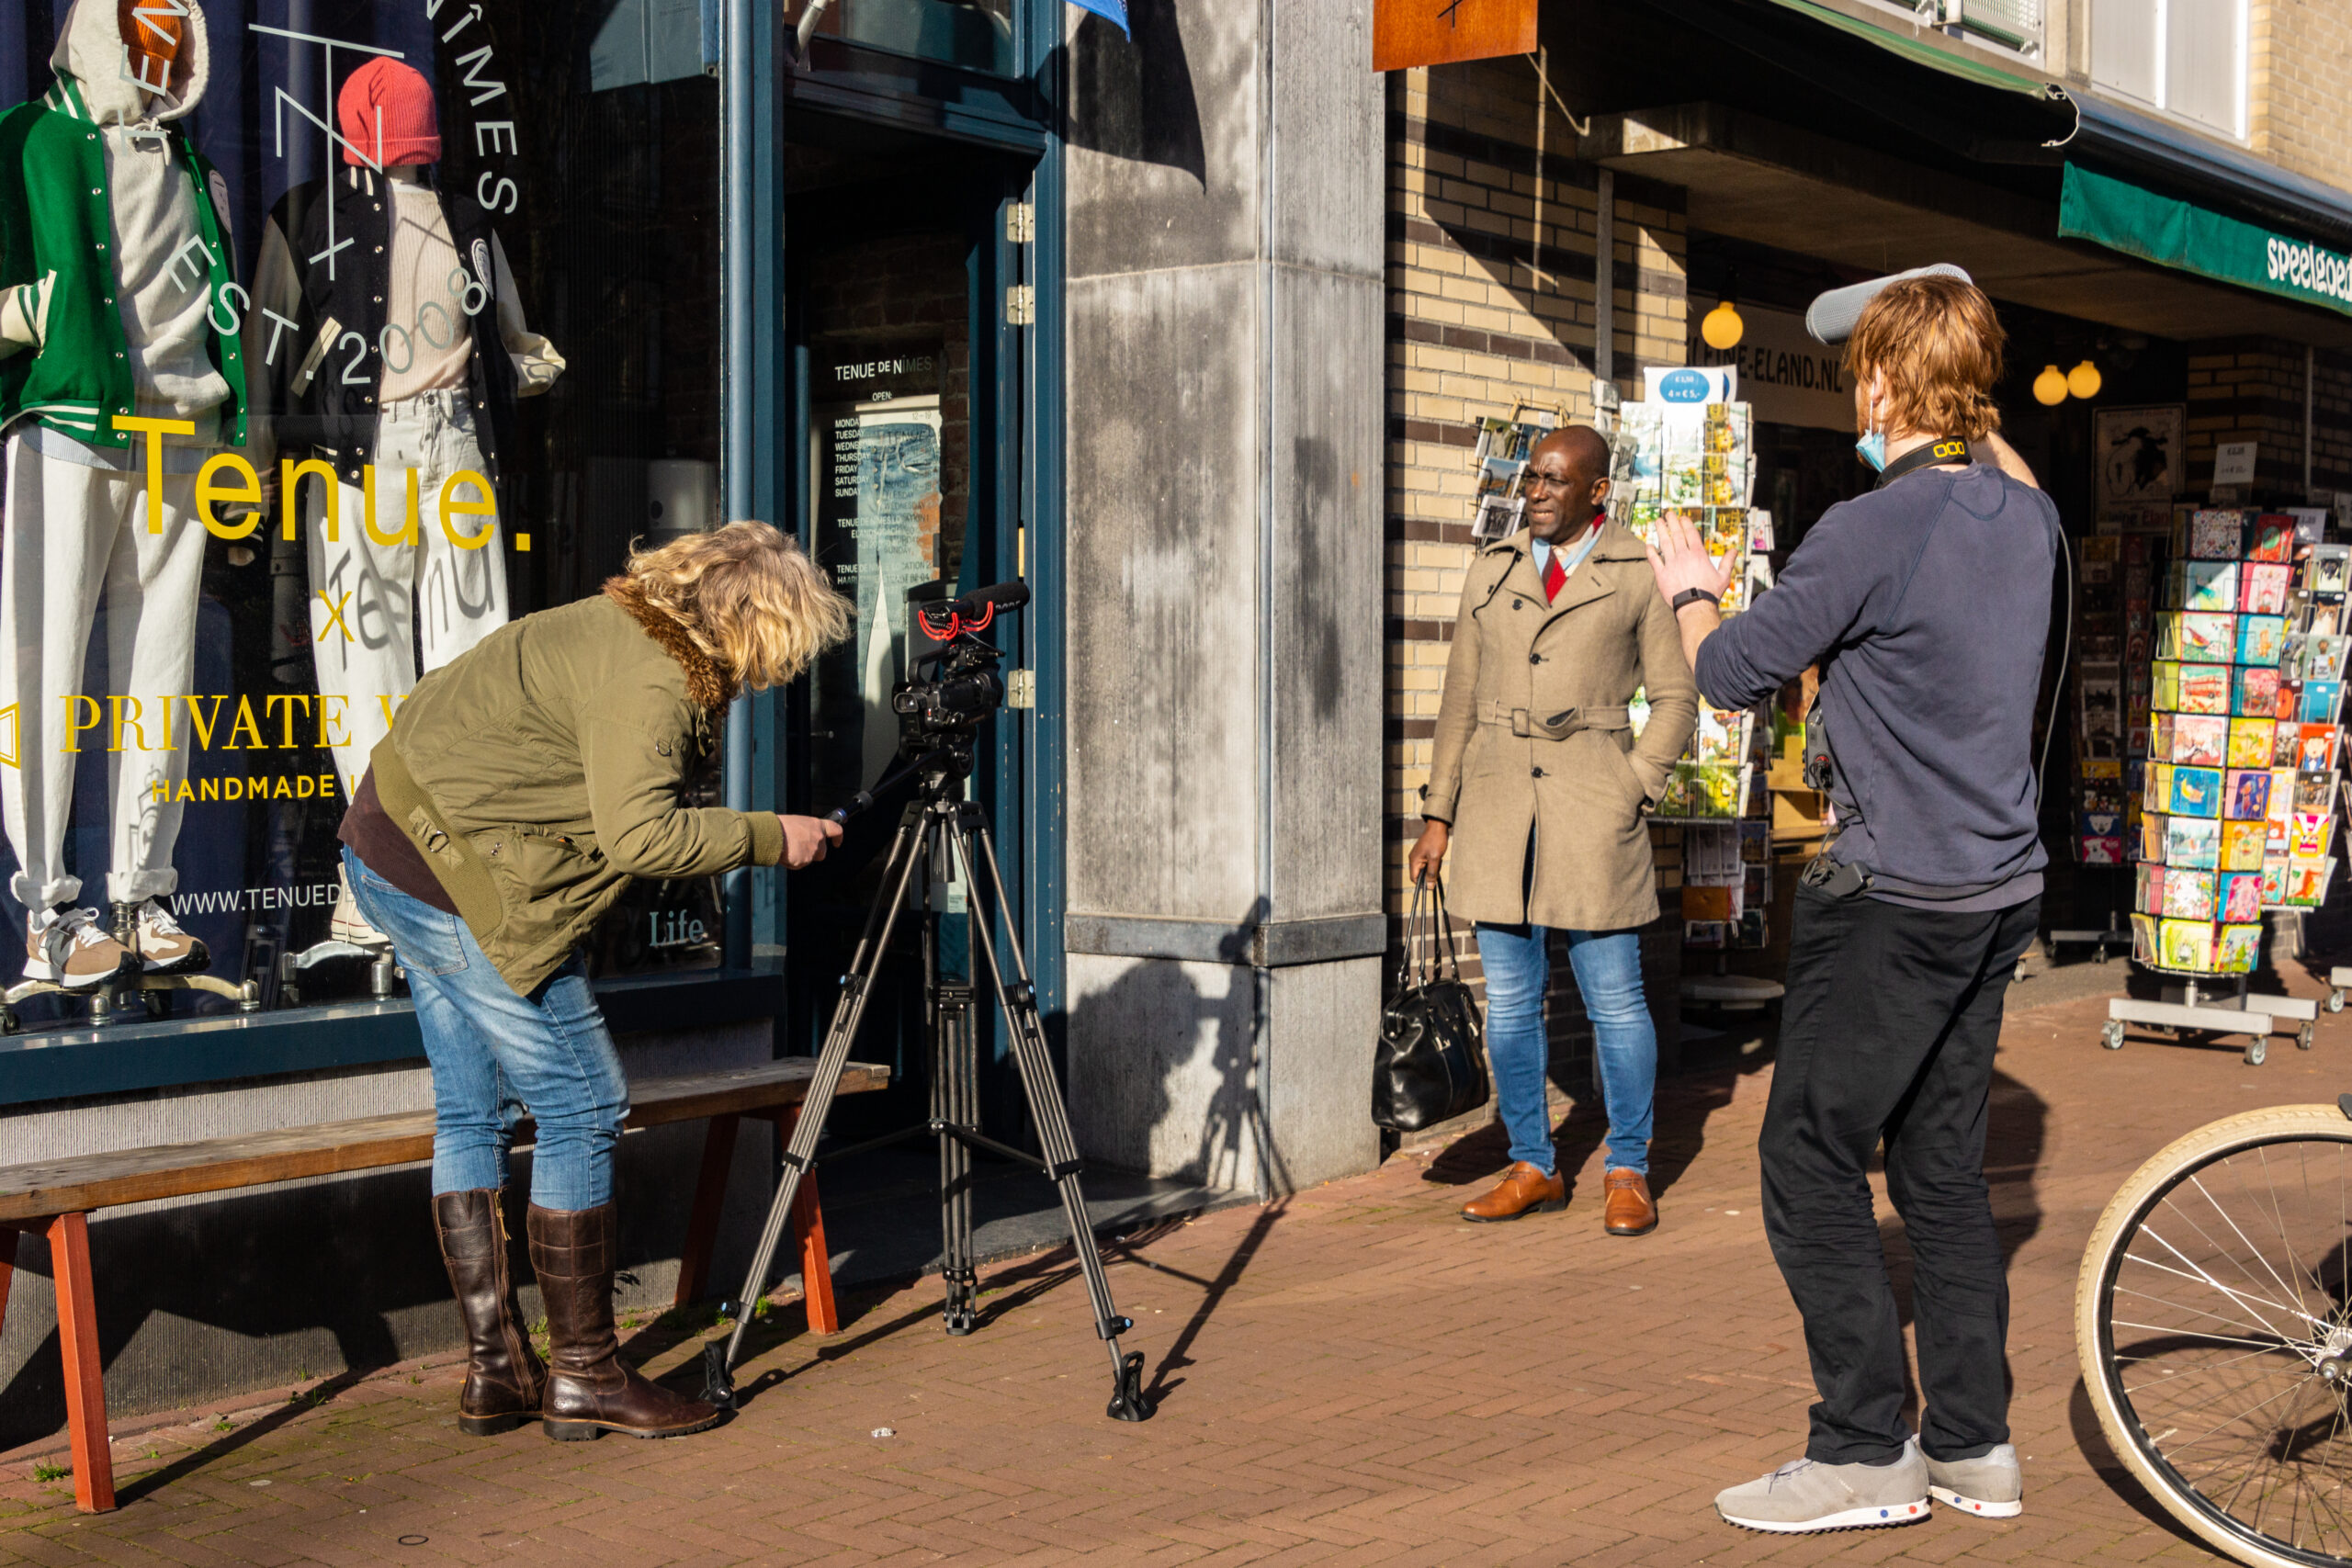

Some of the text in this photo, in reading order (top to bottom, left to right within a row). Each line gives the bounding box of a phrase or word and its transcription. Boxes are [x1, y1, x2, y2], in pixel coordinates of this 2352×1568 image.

[338, 266, 487, 385] 2008
[835, 363, 875, 380] TENUE
[878, 361, 891, 372] DE
[835, 418, 861, 428] MONDA
[835, 429, 865, 440] TUESDAY
[835, 453, 870, 463] THURSDAY
[835, 465, 858, 475] FRIDAY
[112, 415, 531, 551] Tenue.
[835, 476, 870, 486] SATURDAY
[59, 694, 352, 752] PRIVATE
[152, 774, 334, 802] HANDMADE
[649, 909, 704, 947] Life
